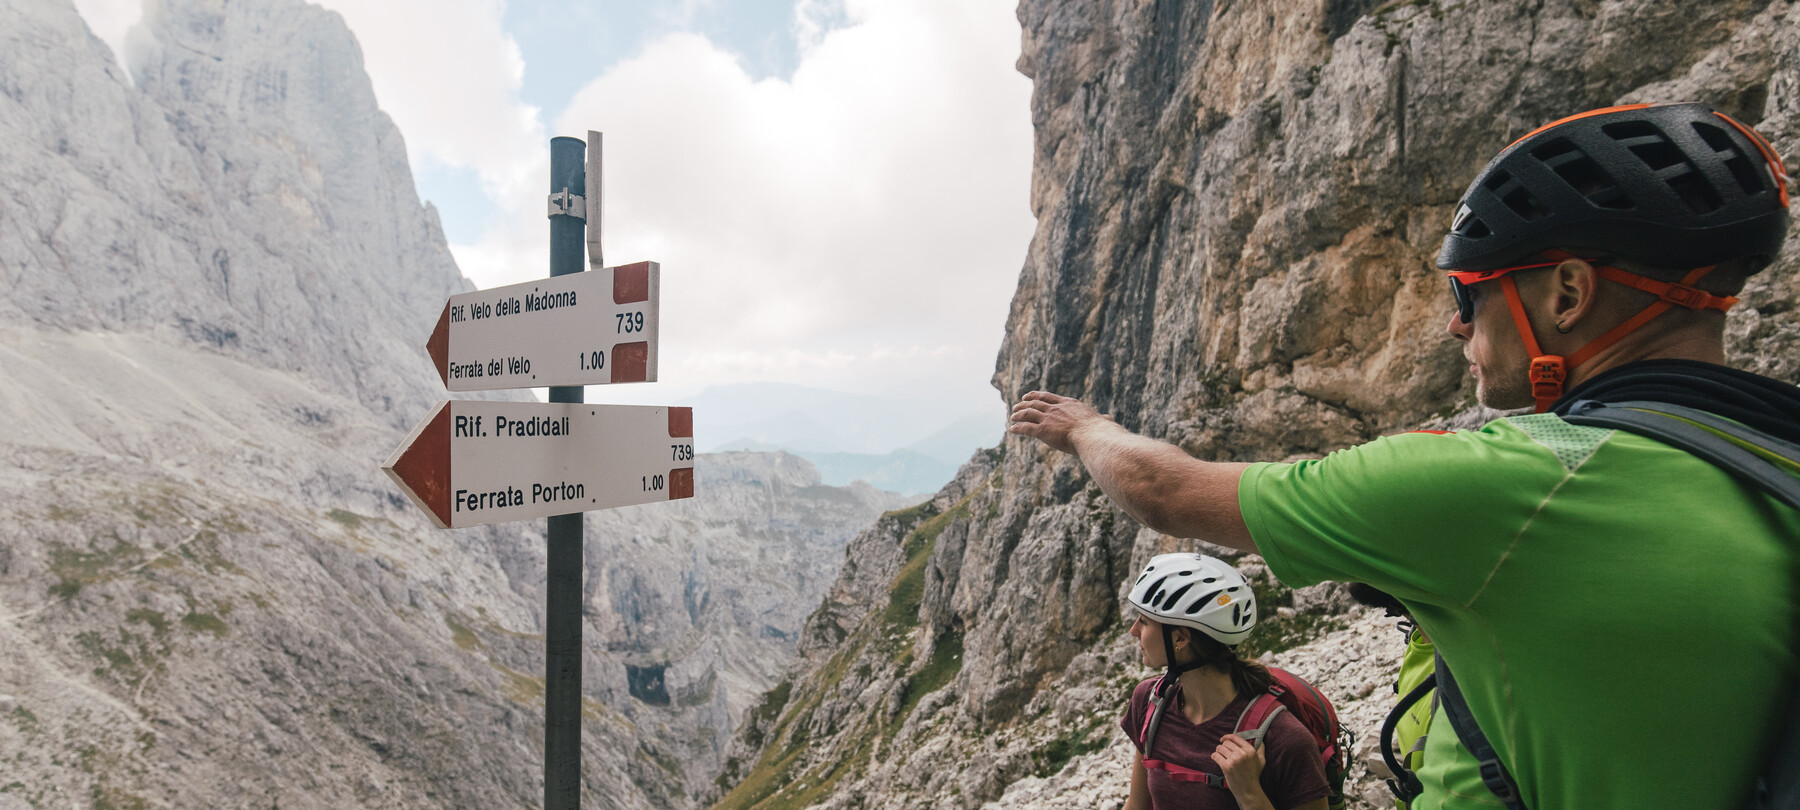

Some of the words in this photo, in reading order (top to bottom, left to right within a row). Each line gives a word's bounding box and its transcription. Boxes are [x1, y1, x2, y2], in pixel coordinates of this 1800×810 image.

[451, 305, 466, 322] Rif.
[471, 302, 491, 320] Velo
[496, 297, 520, 317] della
[525, 290, 577, 312] Madonna
[615, 311, 644, 334] 739
[449, 360, 483, 379] Ferrata
[488, 358, 503, 376] del
[508, 356, 531, 375] Velo
[580, 350, 605, 370] 1.00
[455, 415, 487, 437] Rif.
[496, 416, 570, 437] Pradidali
[641, 474, 664, 492] 1.00
[456, 485, 524, 512] Ferrata
[532, 481, 585, 504] Porton
